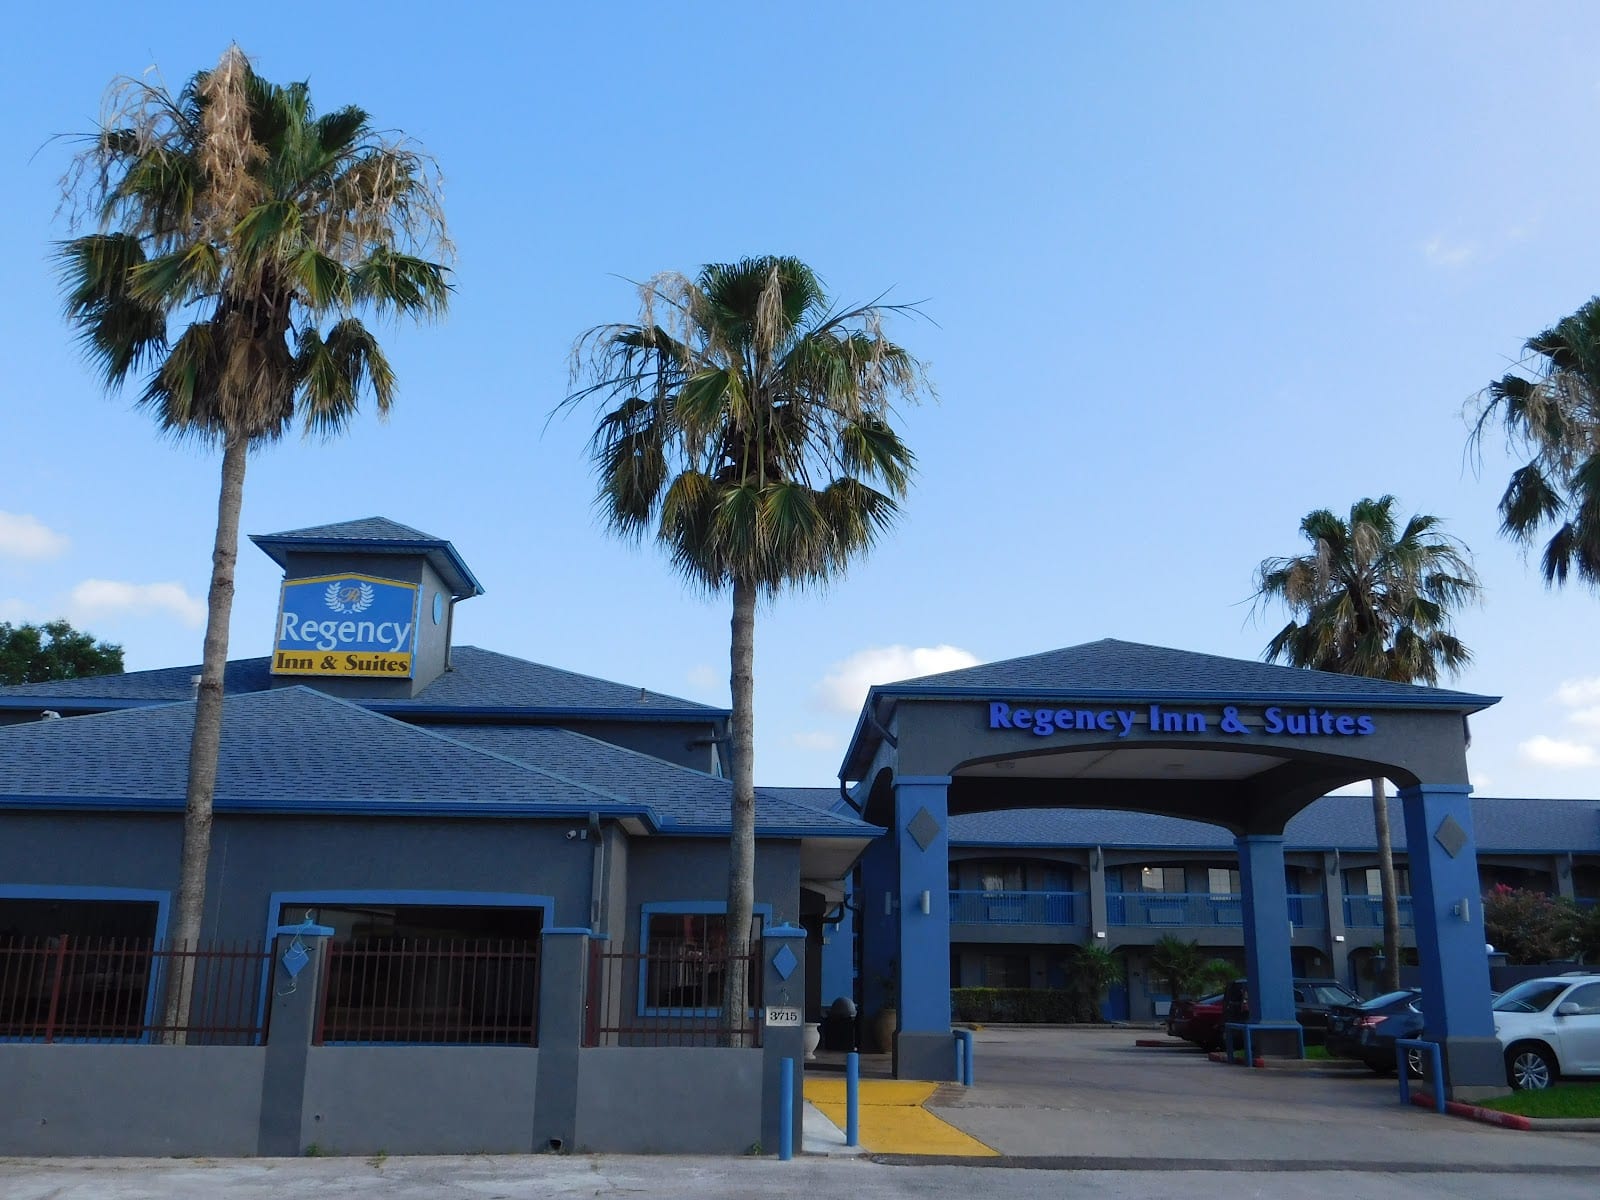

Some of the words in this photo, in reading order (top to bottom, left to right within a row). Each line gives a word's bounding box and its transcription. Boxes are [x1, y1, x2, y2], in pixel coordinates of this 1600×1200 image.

[279, 612, 411, 652] Regency
[276, 653, 313, 670] Inn
[320, 655, 337, 670] &
[344, 654, 408, 672] Suites
[989, 702, 1136, 737] Regency
[1150, 705, 1207, 732] Inn
[1221, 705, 1250, 733] &
[1264, 706, 1376, 735] Suites
[770, 1011, 798, 1021] 3715
